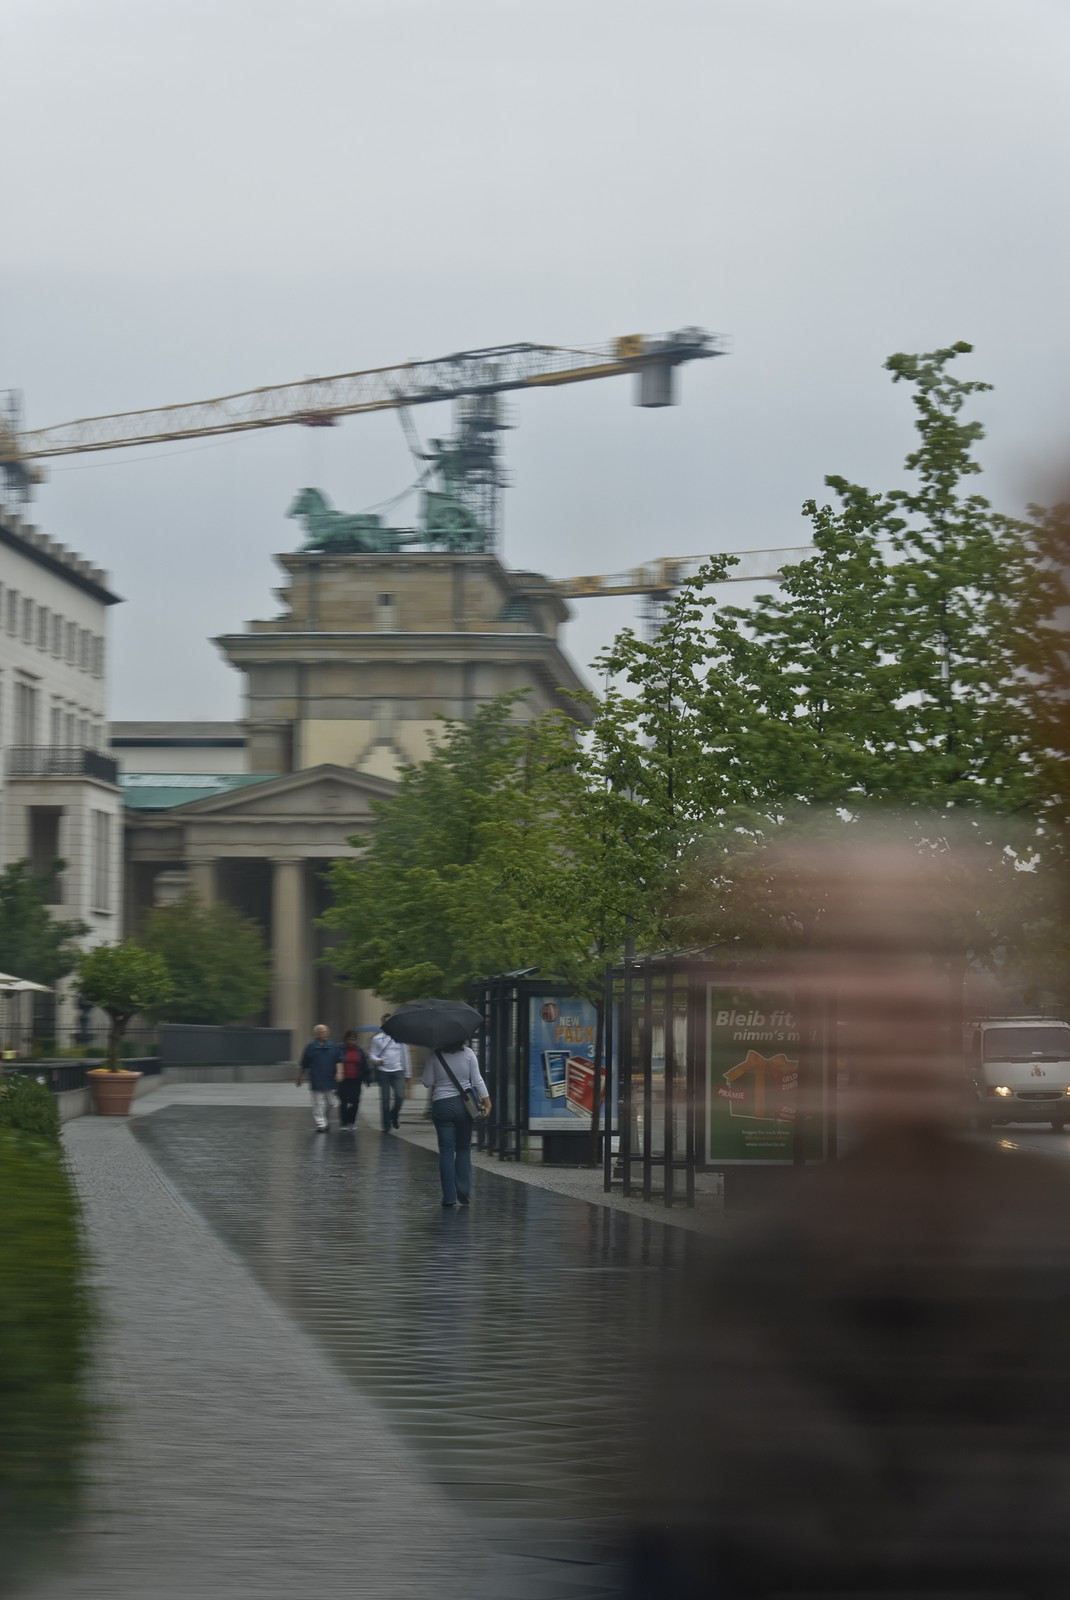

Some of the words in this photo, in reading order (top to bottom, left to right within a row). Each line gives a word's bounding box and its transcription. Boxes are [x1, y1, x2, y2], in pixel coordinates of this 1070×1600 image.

[559, 1016, 580, 1026] NEW
[715, 1010, 766, 1026] Bleib
[770, 1010, 797, 1028] fit,
[554, 1025, 596, 1044] PACK
[733, 1029, 785, 1041] nimm's
[717, 1088, 745, 1099] PRÄMIE
